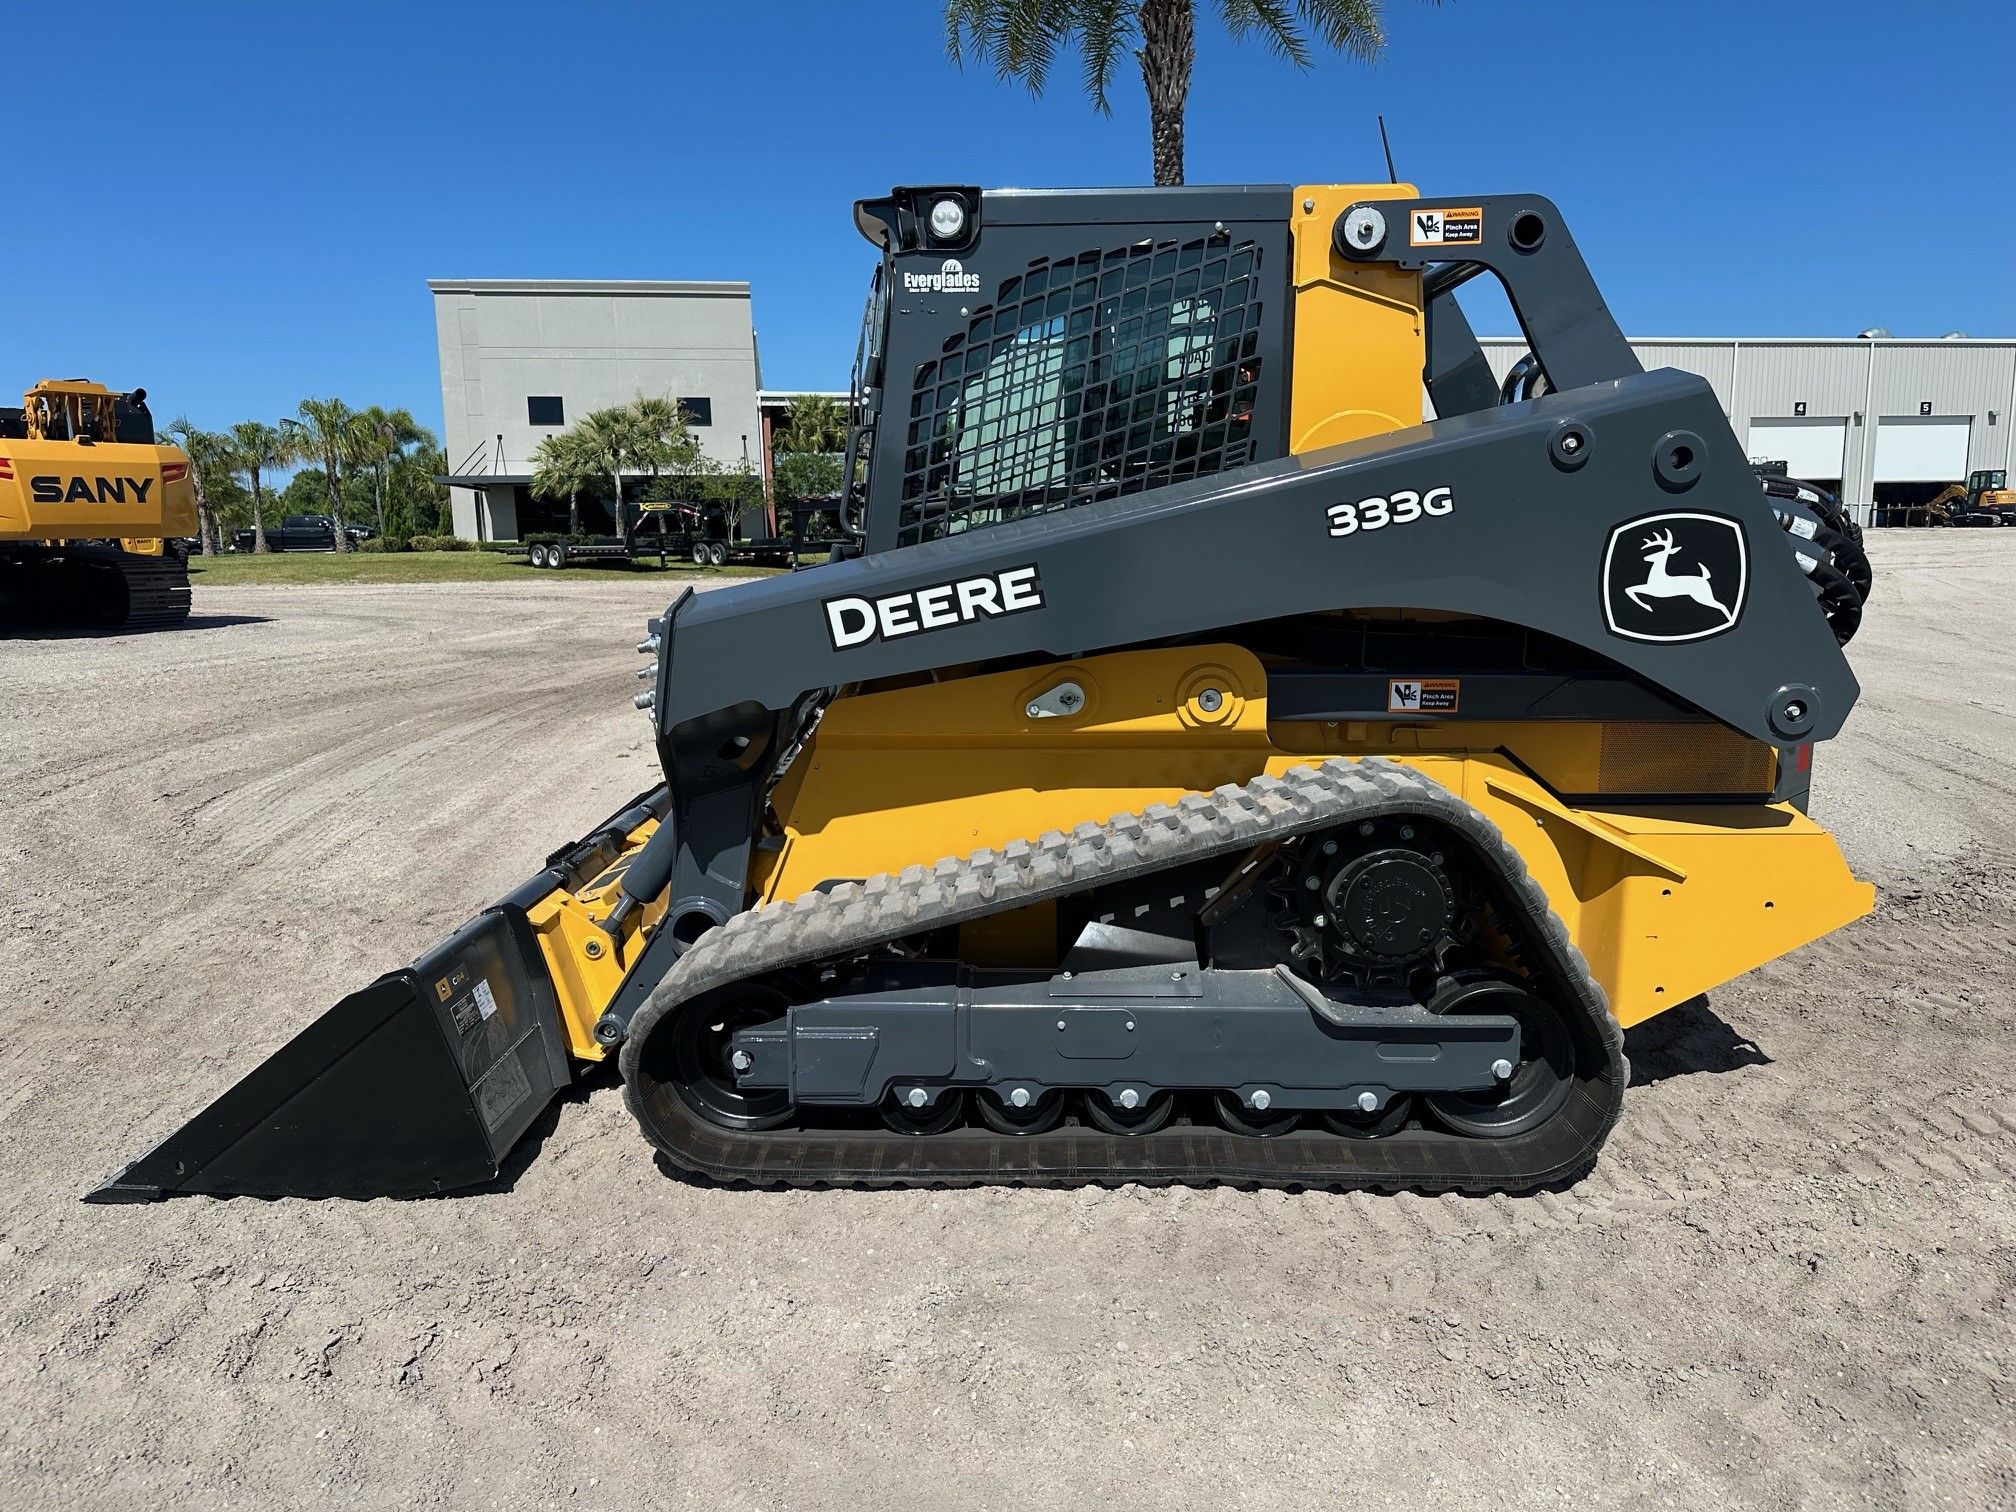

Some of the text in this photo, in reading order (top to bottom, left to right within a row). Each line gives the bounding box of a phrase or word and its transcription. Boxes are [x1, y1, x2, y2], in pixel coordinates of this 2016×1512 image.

[904, 272, 980, 291] Everglades
[1796, 403, 1805, 412] 4
[1922, 403, 1930, 412] 5
[30, 475, 155, 503] SANY
[1327, 487, 1454, 536] 333G
[826, 566, 1042, 648] DEERE
